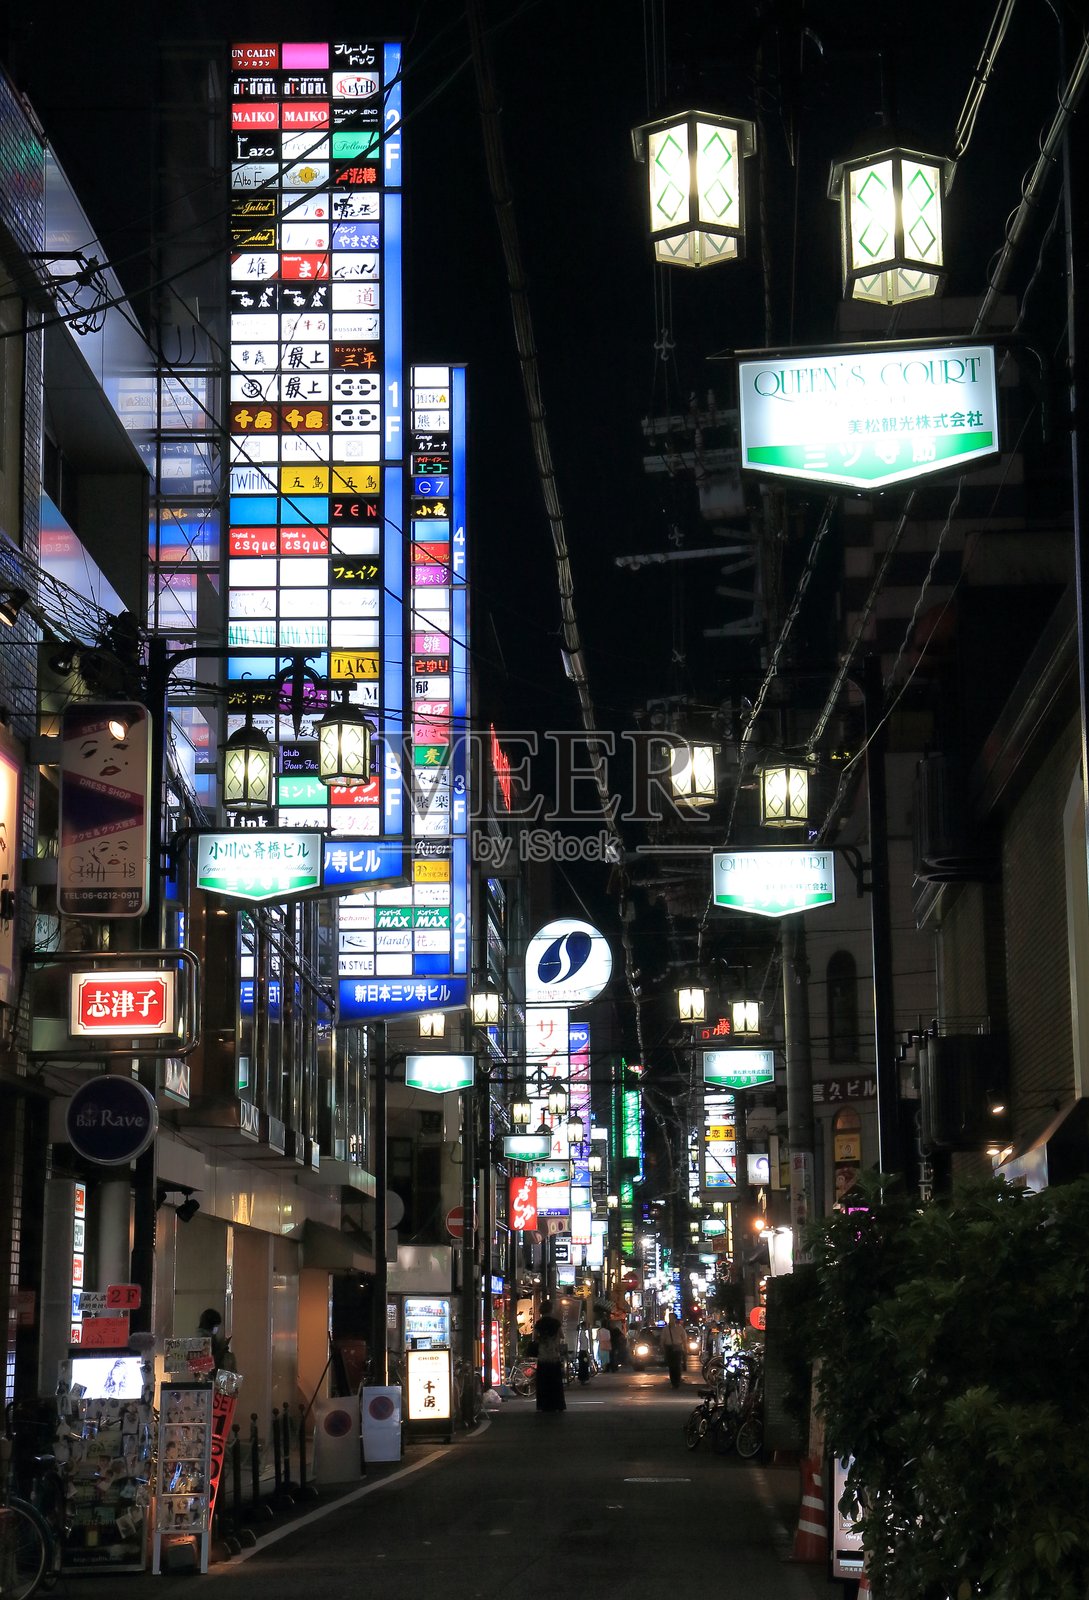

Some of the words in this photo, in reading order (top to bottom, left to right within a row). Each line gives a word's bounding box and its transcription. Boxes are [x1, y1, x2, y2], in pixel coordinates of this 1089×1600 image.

[247, 49, 276, 57] CALIN
[334, 44, 375, 55] プレーリー
[232, 112, 275, 122] MAIKO
[284, 111, 328, 122] MAIKO
[338, 235, 379, 249] やまざき
[356, 287, 377, 307] 道
[288, 346, 325, 370] 最上
[341, 352, 377, 370] 三平
[880, 356, 981, 386] COURT
[285, 376, 322, 400] 最上
[418, 441, 448, 451] ルアーナ
[418, 463, 448, 473] エーコー
[334, 504, 377, 517] ZEN
[234, 541, 277, 553] esque
[285, 540, 328, 553] esque
[333, 566, 378, 580] フェイク
[415, 574, 448, 584] ジャスミン
[334, 658, 379, 674] TAKA
[415, 660, 448, 673] さゆり
[415, 680, 429, 694] 郁
[423, 748, 441, 765] 麦
[80, 778, 107, 793] DRESS
[108, 787, 131, 800] SHOP
[415, 840, 450, 856] River
[128, 900, 139, 909] 2F
[377, 916, 410, 928] MAX
[415, 916, 449, 928] MAX
[348, 961, 373, 971] STYLE
[355, 984, 451, 1003] 新日本三ツ寺ビル
[86, 989, 158, 1018] 志津子
[76, 1114, 97, 1128] Bar
[101, 1109, 145, 1128] Rave
